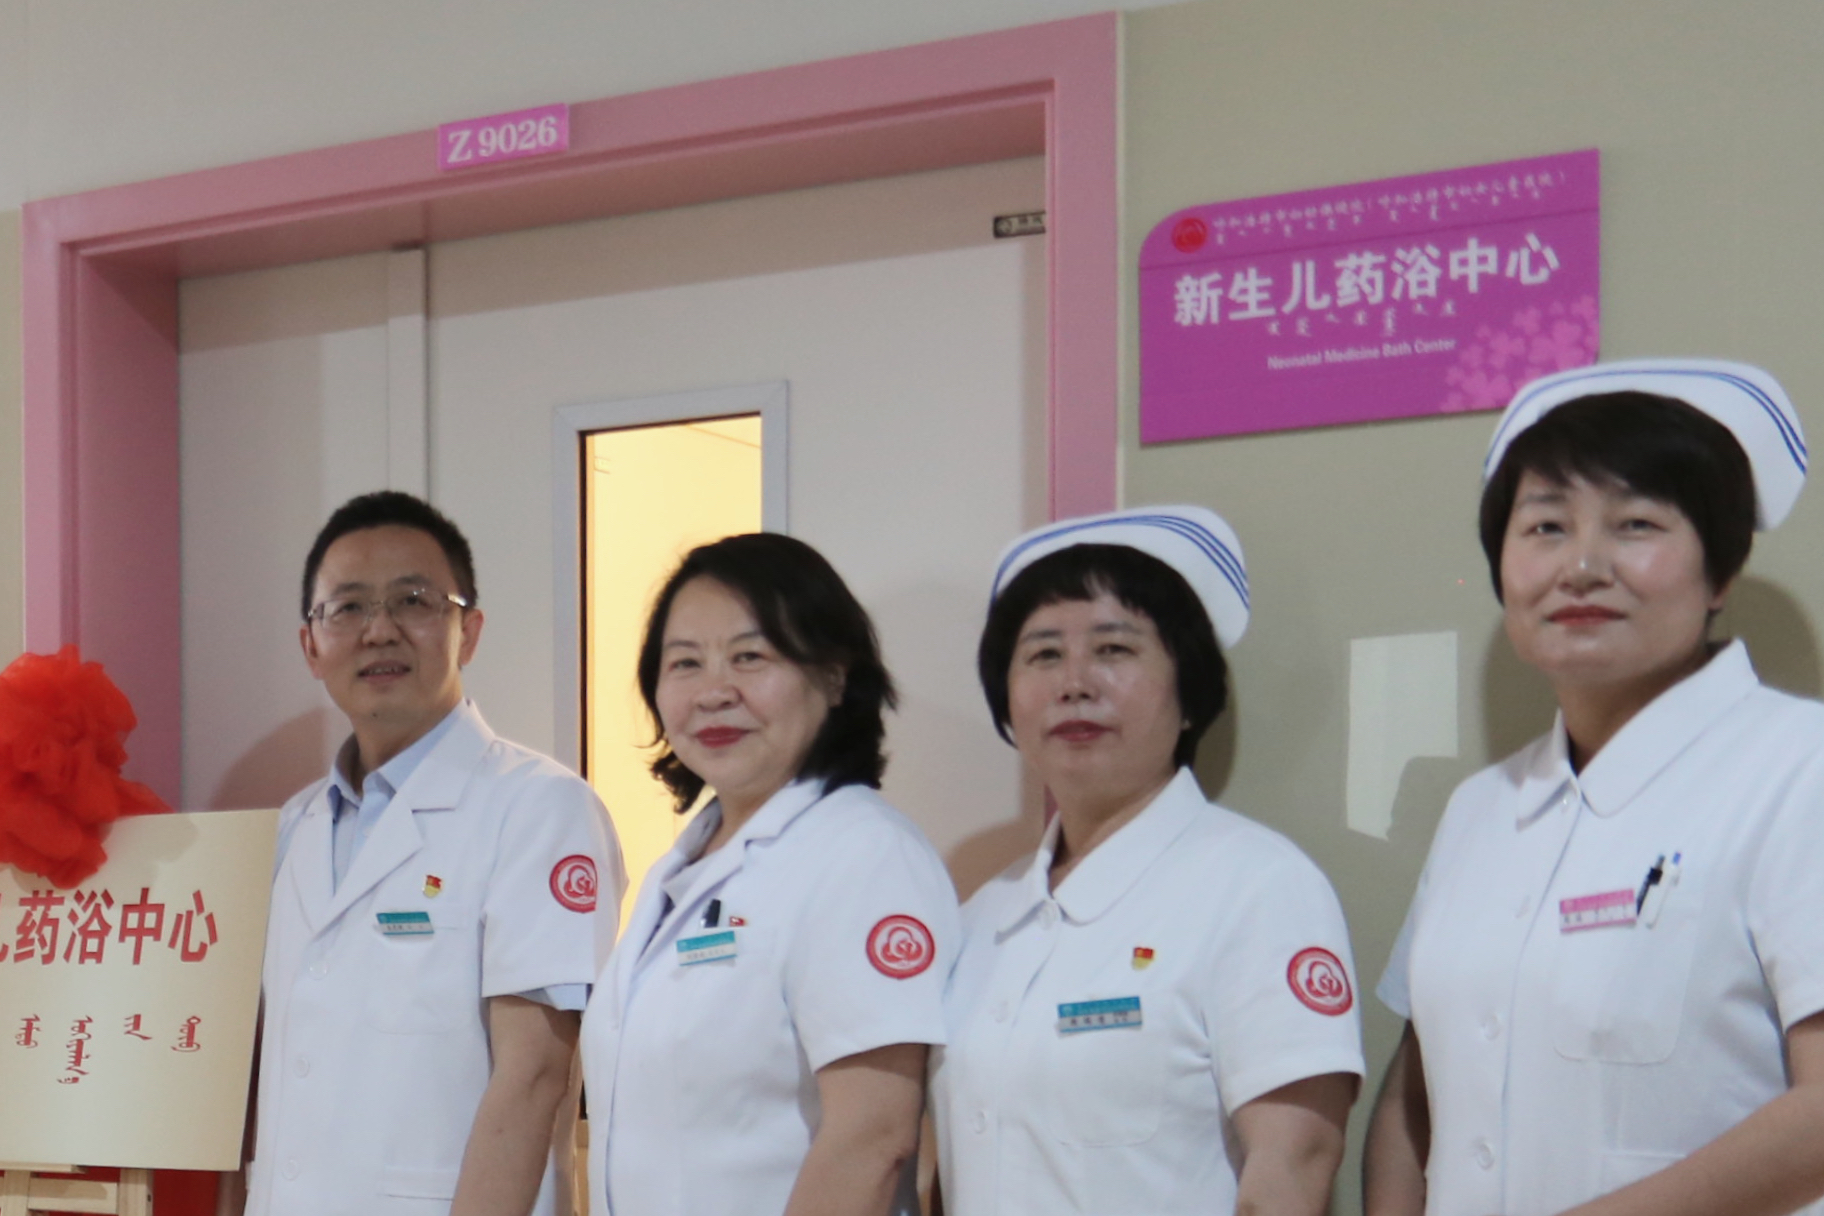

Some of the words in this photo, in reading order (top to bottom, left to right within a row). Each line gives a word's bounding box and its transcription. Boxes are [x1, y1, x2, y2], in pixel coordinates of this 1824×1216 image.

[446, 129, 473, 164] Z
[477, 115, 558, 158] 9026
[1173, 232, 1560, 327] 新生儿药浴中心
